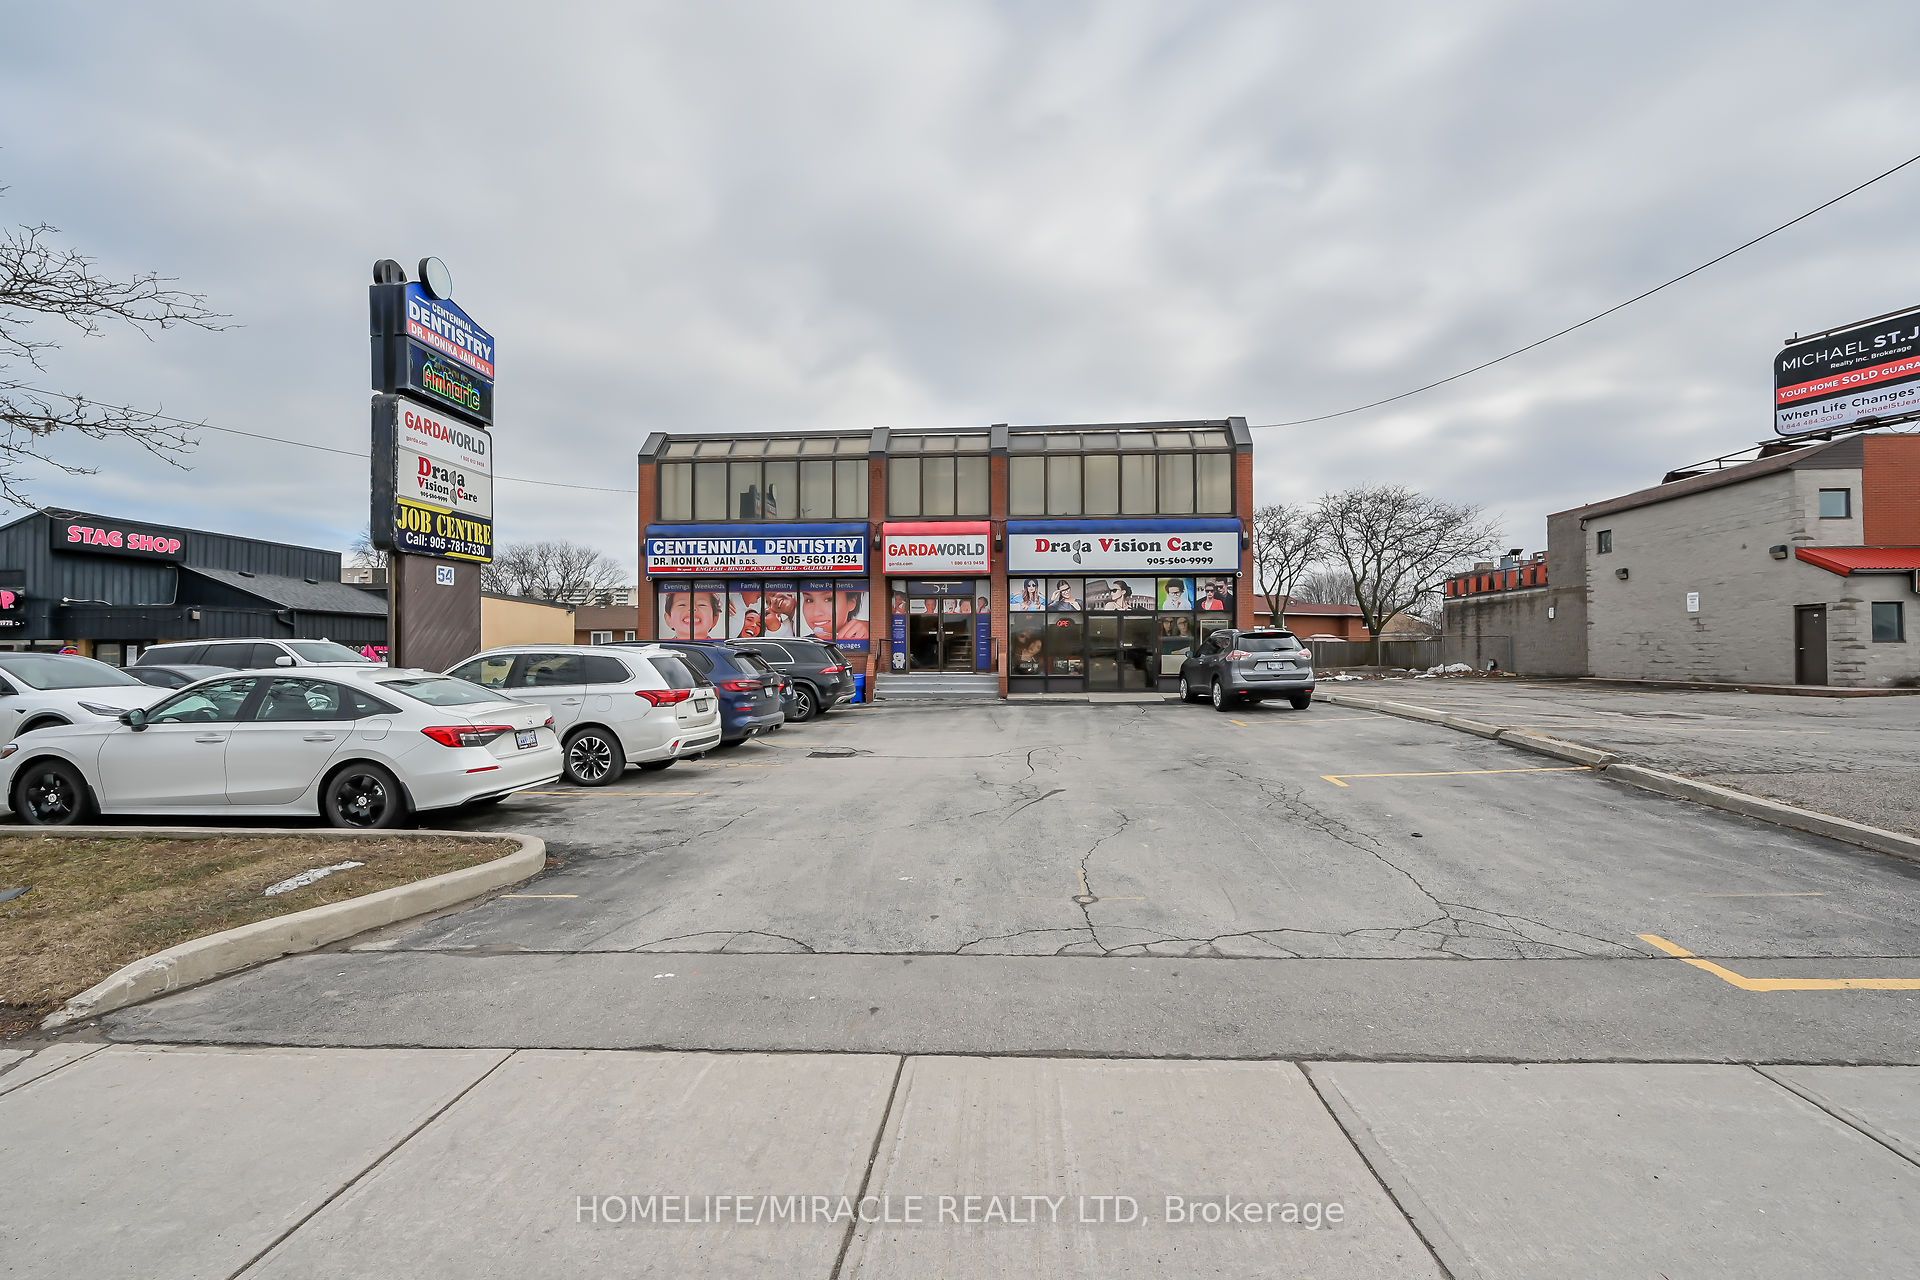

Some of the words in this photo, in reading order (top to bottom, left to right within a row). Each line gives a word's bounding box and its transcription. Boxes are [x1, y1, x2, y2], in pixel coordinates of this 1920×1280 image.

[408, 300, 492, 360] DENTISTRY
[432, 302, 472, 334] CENTENNIAL
[411, 323, 426, 340] DR.
[428, 332, 458, 358] MONIKA
[460, 350, 476, 367] JAIN
[1782, 340, 1870, 372] MICHAEL
[1874, 330, 1906, 348] ST.
[1830, 360, 1854, 368] Realty
[1871, 345, 1912, 360] Brokerage
[1780, 388, 1807, 398] YOUR
[1810, 380, 1839, 392] HOME
[1842, 370, 1878, 384] SOLD
[1781, 408, 1818, 422] When
[1822, 403, 1846, 414] Life
[1852, 388, 1915, 408] Changes
[417, 476, 449, 495] Vision
[457, 488, 478, 502] Care
[398, 506, 432, 534] JOB
[436, 514, 491, 546] CENTRE
[68, 526, 122, 548] STAG
[128, 533, 180, 554] SHOP
[406, 532, 428, 546] Call:
[430, 536, 446, 550] 905
[653, 540, 758, 554] CENTENNIAL
[765, 540, 858, 554] DENTISTRY
[888, 544, 984, 556] GARDAWORLD
[1098, 538, 1161, 552] Vision
[1167, 537, 1213, 552] Care
[654, 557, 668, 566] DR.
[671, 557, 710, 565] MONIKA
[714, 556, 736, 565] JAIN
[780, 555, 858, 564] 905-560-1294
[1146, 557, 1214, 566] 905-560-9999
[438, 568, 452, 583] 54
